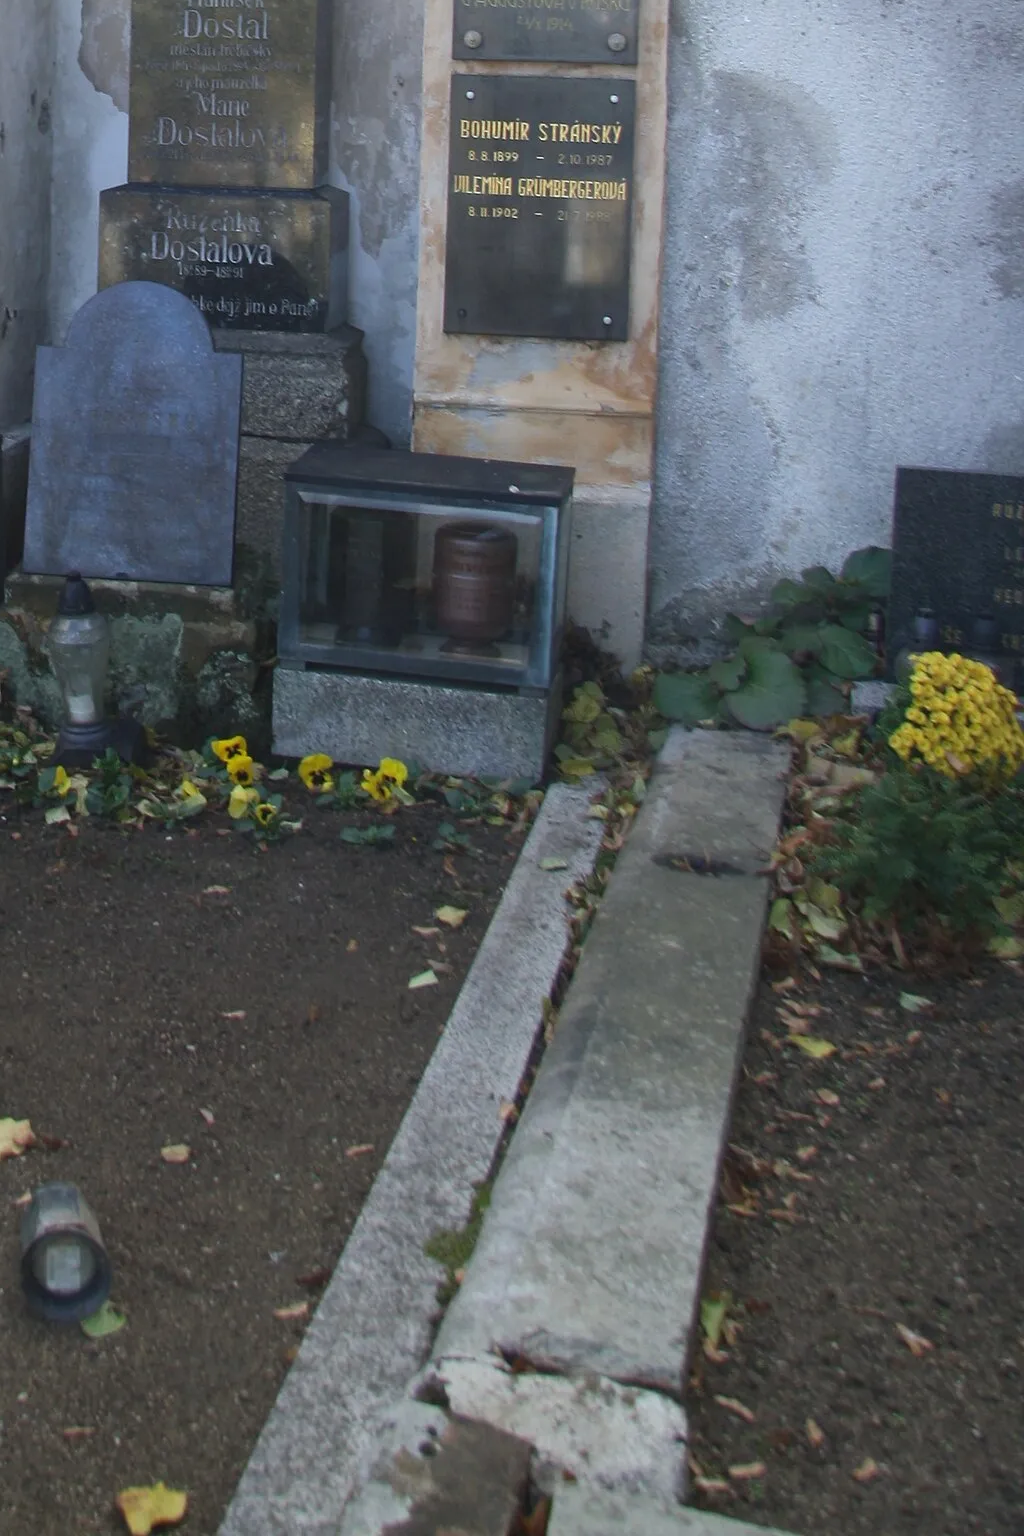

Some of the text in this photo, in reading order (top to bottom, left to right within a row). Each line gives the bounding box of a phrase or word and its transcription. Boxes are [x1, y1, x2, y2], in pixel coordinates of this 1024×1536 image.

[460, 117, 623, 144] BOHUMÍR STRÁNSKÝ
[454, 172, 512, 196] VILEMÍNA
